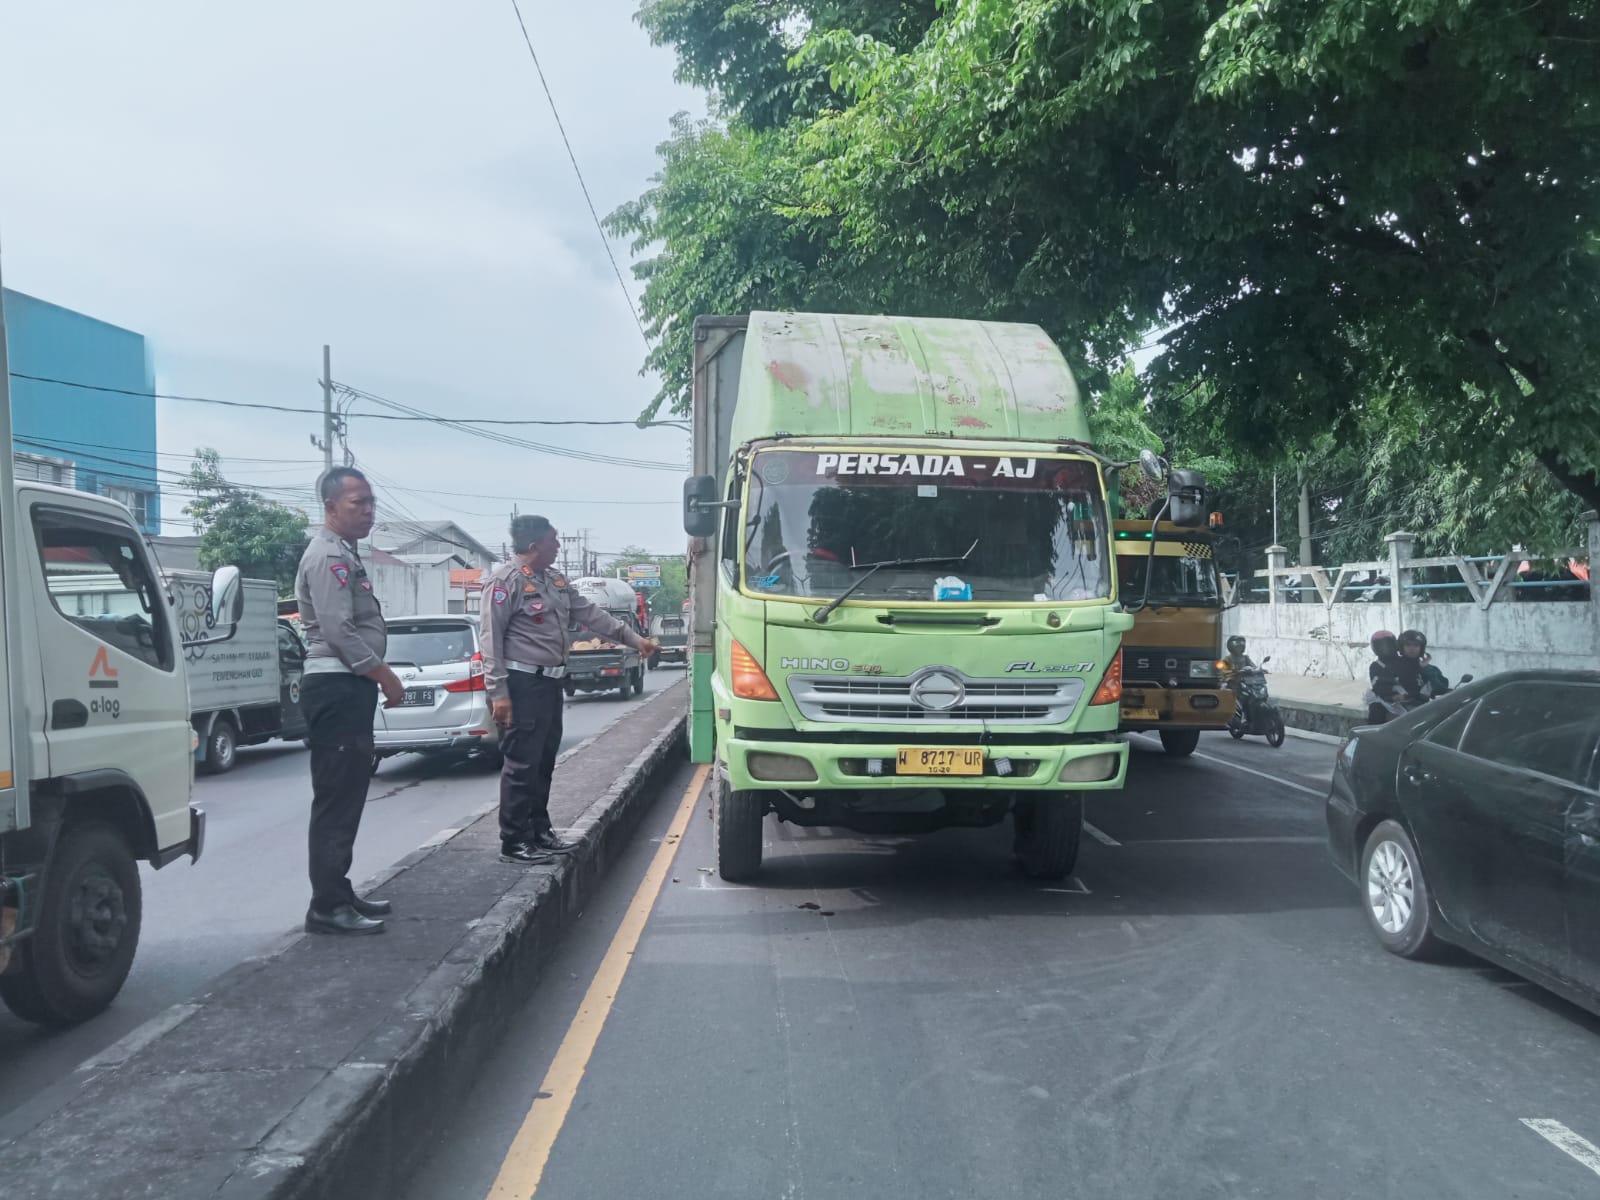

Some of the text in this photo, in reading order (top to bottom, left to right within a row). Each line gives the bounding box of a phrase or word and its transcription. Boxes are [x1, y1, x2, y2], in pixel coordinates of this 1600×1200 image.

[816, 454, 965, 476] PERSADA
[992, 457, 1036, 479] AJ
[781, 657, 849, 671] HINO
[1137, 658, 1178, 669] SO
[423, 691, 432, 700] FS
[899, 751, 981, 765] W 8717 UR
